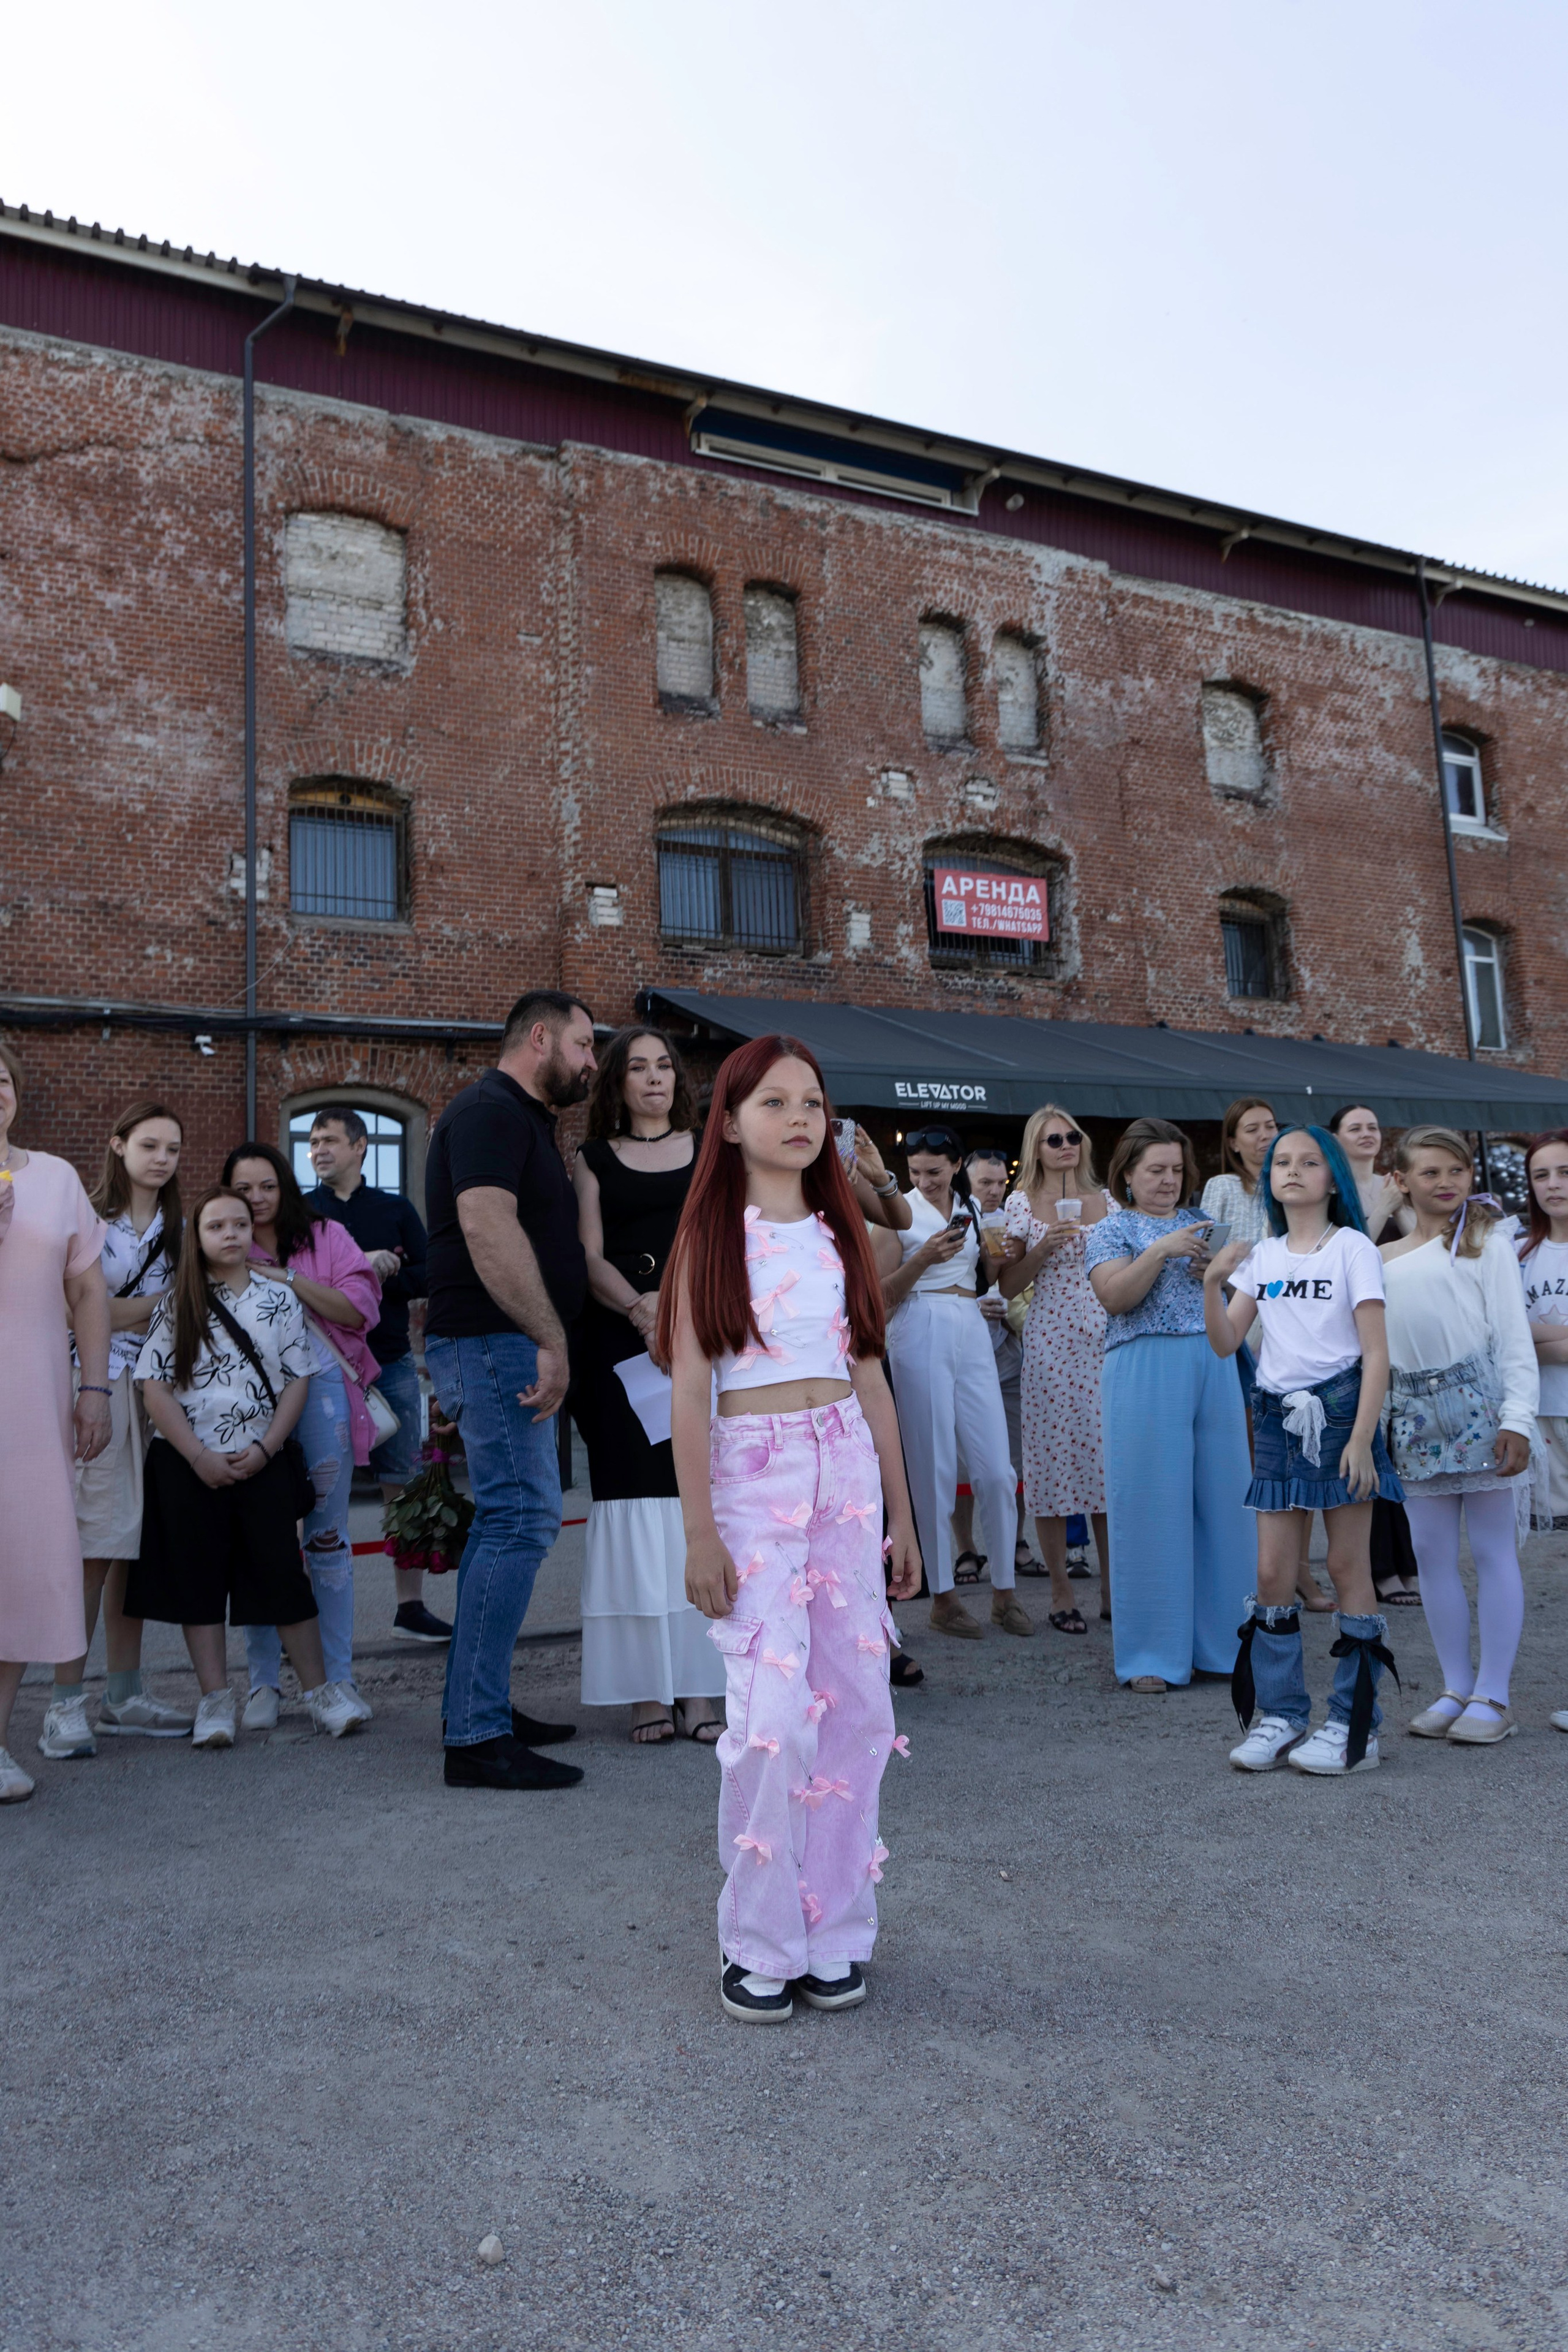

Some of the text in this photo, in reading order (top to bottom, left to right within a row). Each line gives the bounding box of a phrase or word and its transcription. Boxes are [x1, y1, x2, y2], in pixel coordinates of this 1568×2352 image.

[941, 875, 1041, 905] АРЕНДА
[895, 1082, 987, 1101] ELEVATOR
[1256, 1280, 1333, 1301] I ME
[1525, 1278, 1568, 1313] MAZ
